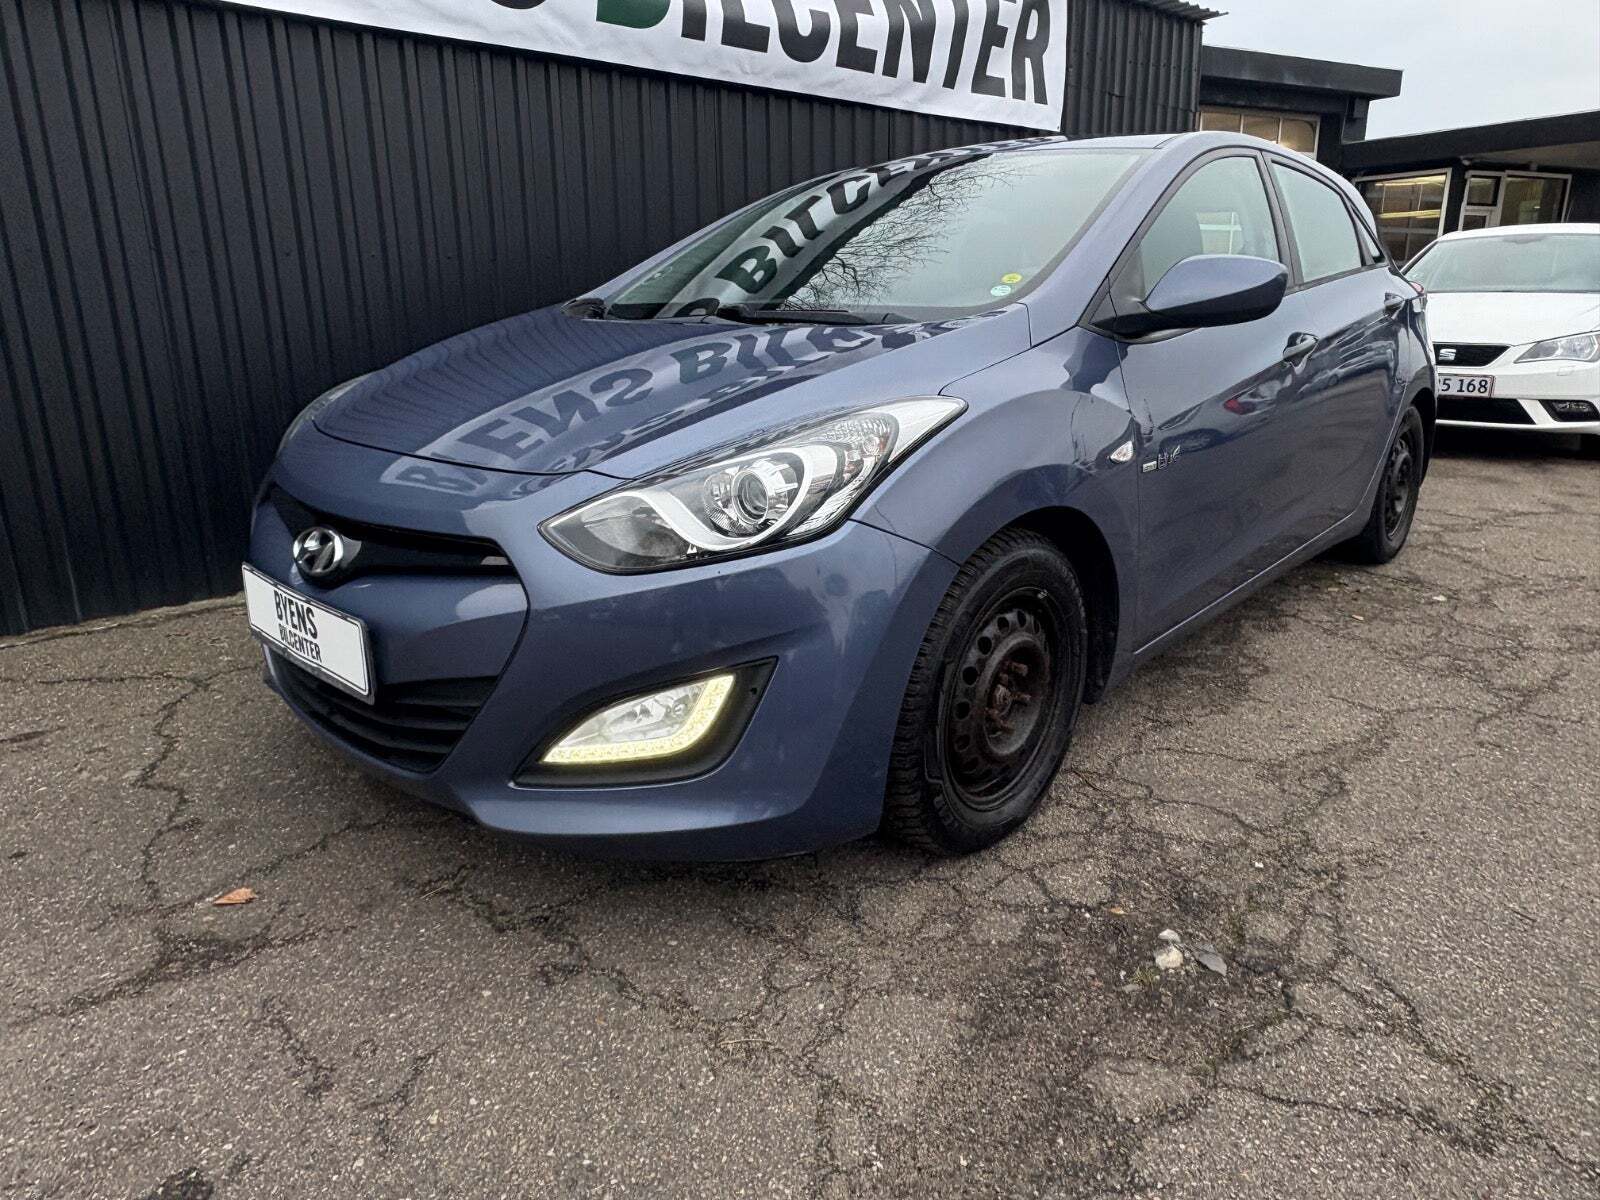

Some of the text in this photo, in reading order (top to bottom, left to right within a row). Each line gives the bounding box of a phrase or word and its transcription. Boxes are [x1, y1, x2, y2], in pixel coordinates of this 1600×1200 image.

[596, 0, 1048, 105] ILCENTER
[1438, 378, 1488, 393] 5 168
[274, 590, 317, 639] BYENS
[279, 624, 322, 663] BILCENTER
